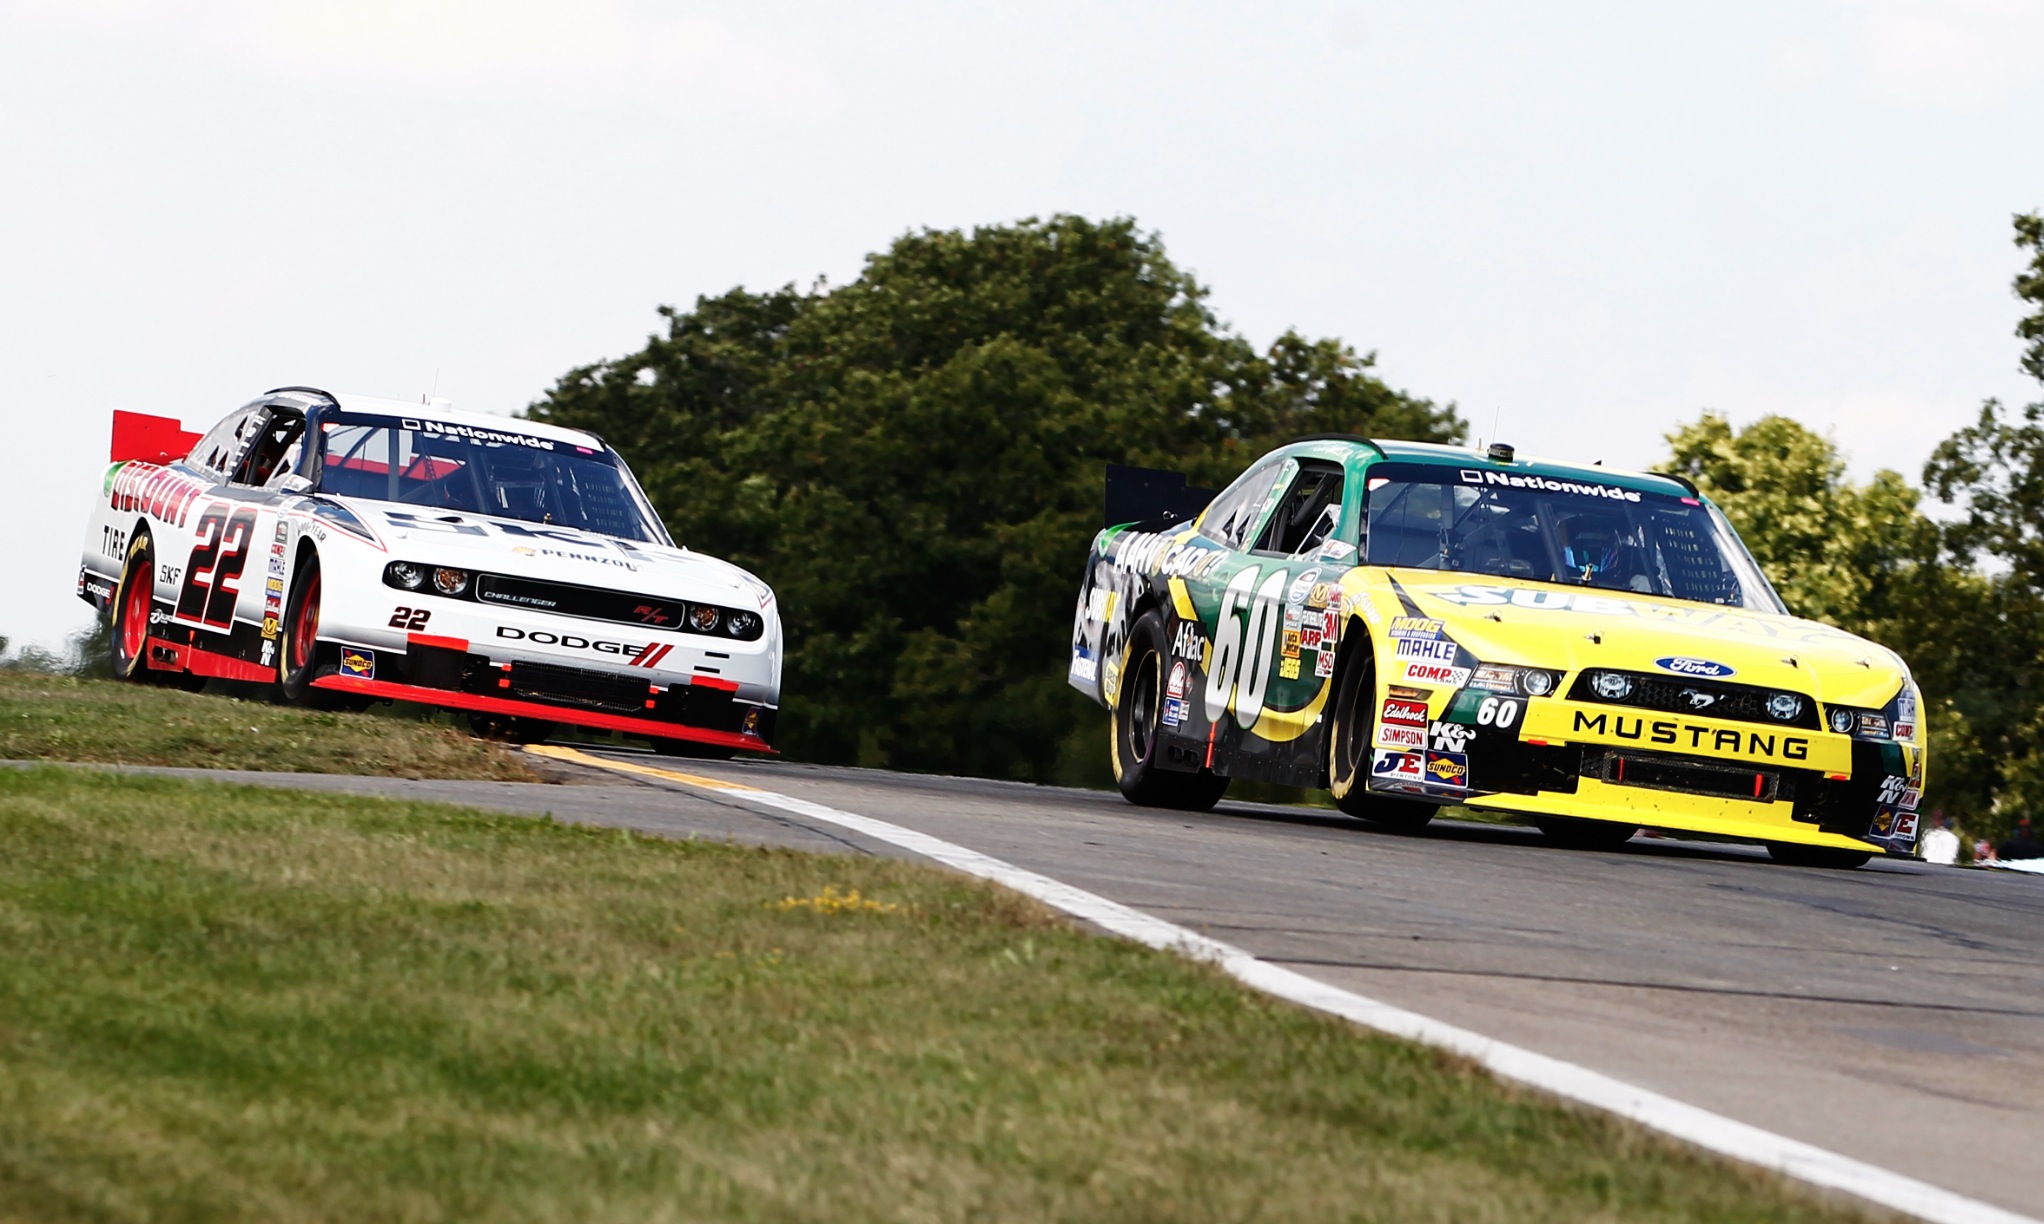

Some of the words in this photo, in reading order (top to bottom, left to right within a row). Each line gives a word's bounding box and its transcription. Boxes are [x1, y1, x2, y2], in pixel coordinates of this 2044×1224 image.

[425, 421, 554, 451] Nationwide
[1485, 471, 1641, 502] Nationwide
[102, 525, 126, 561] TIRE
[159, 564, 181, 585] SKF
[175, 501, 258, 630] 22
[86, 582, 111, 599] DODGE
[484, 591, 556, 608] CHALLENGER
[388, 606, 432, 631] 22
[633, 605, 669, 624] R/T
[1391, 617, 1441, 632] MOOG
[496, 626, 649, 658] DODGE
[1171, 621, 1205, 662] Aflac
[1205, 563, 1289, 730] 60
[1301, 629, 1321, 647] ARP
[1318, 652, 1334, 669] MSD
[1397, 639, 1456, 661] MAHLE
[344, 658, 373, 670] SUNOCO
[1407, 664, 1453, 680] COMP
[1669, 657, 1721, 678] Ford
[1383, 703, 1426, 723] Edelbrock
[1476, 697, 1518, 729] 60
[1381, 727, 1423, 746] SIMPSON
[1573, 710, 1809, 760] MUSTANG
[1374, 752, 1422, 774] JE
[1427, 762, 1465, 775] SUNOCO
